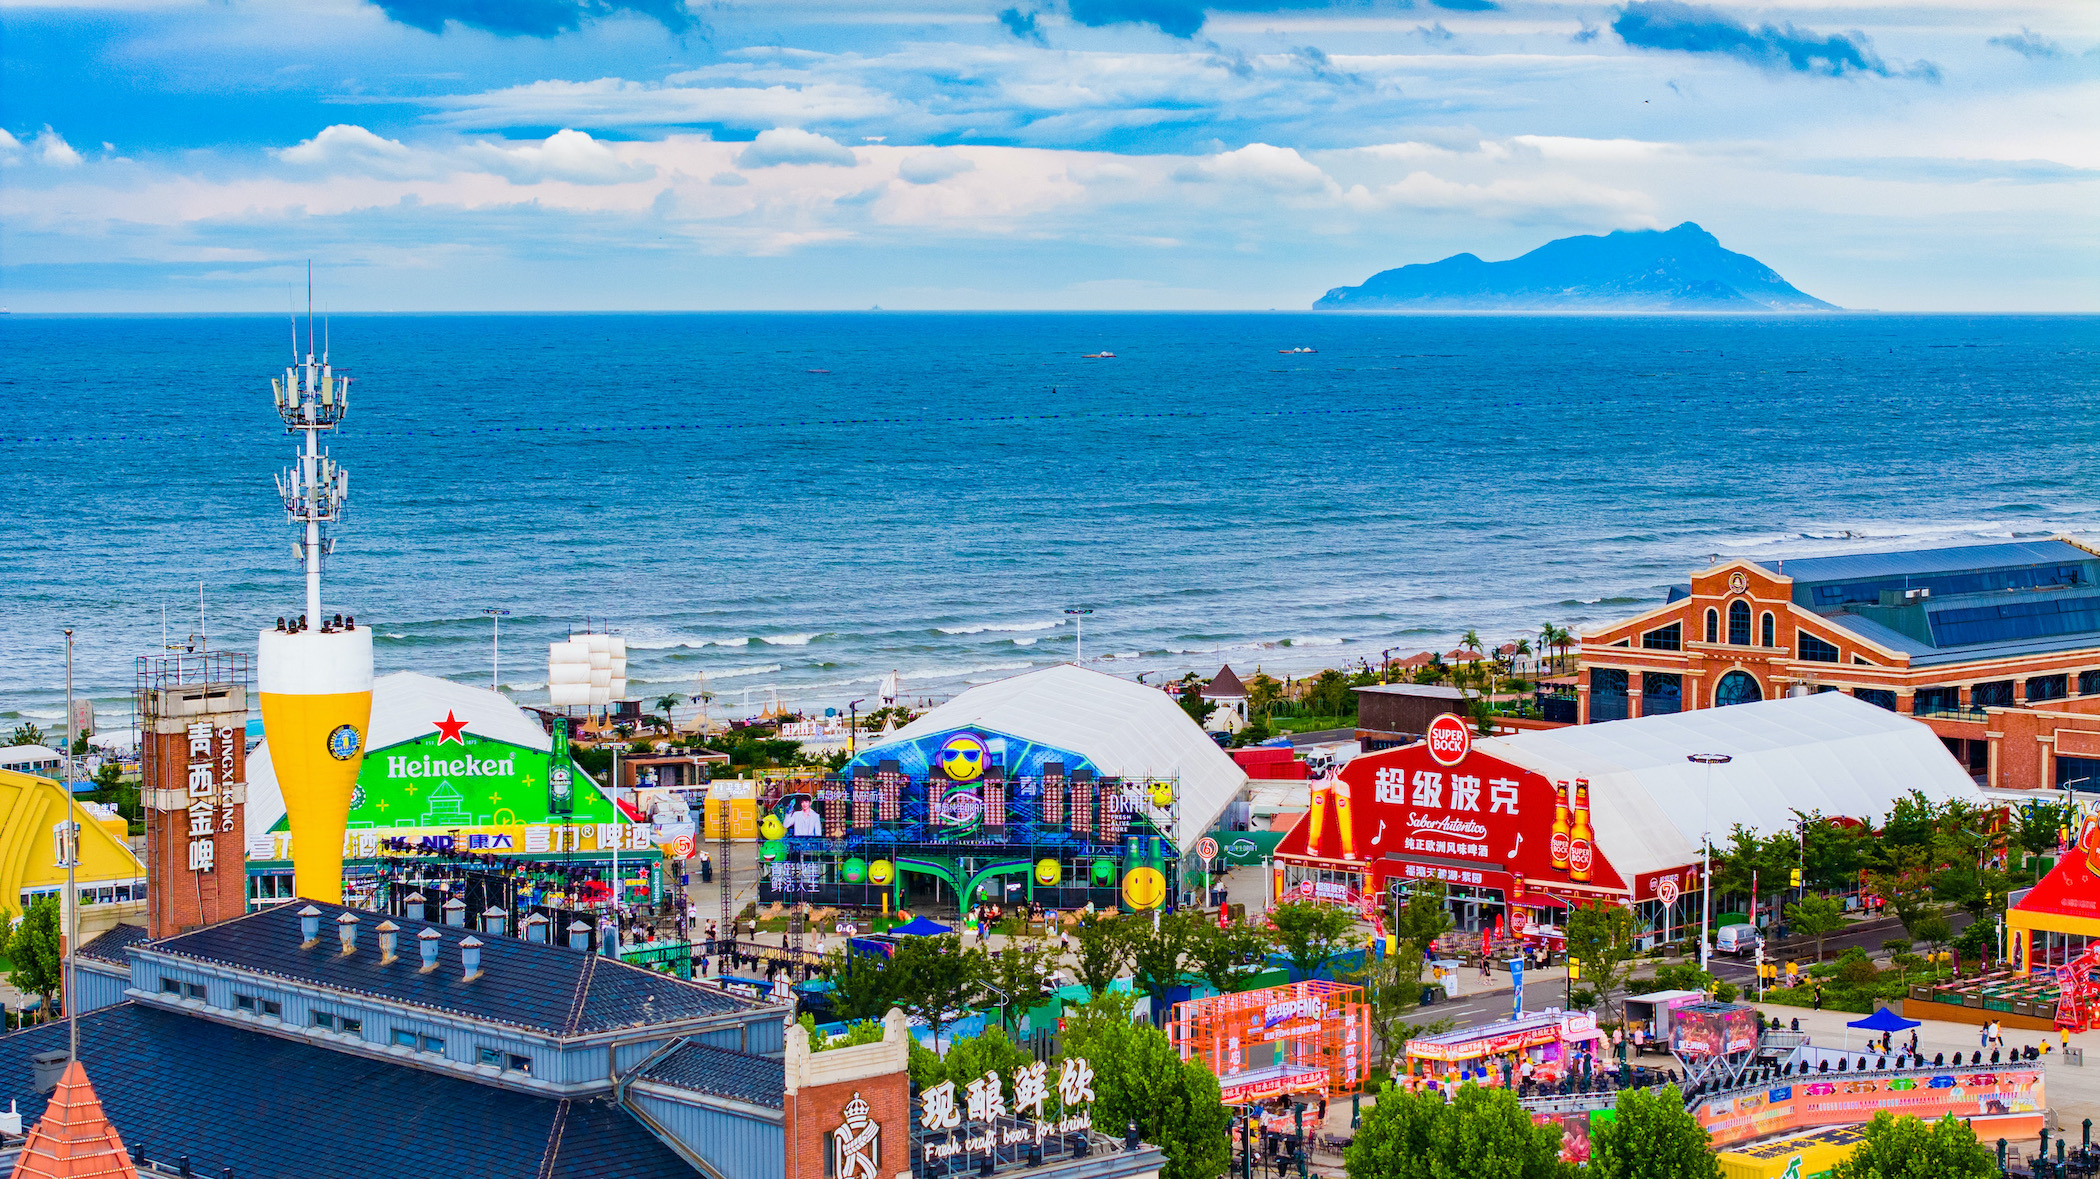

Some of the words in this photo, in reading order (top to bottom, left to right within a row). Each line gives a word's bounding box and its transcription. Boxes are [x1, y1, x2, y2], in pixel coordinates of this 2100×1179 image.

[1432, 728, 1463, 742] SUPER
[1433, 739, 1462, 752] BOCK
[219, 726, 234, 787] QINGXI
[387, 754, 516, 778] Heineken
[188, 722, 214, 873] 青西金啤
[1375, 767, 1520, 815] 超级波克
[222, 790, 235, 833] KING
[1406, 811, 1439, 829] Sabor
[469, 833, 513, 849] 康大
[678, 840, 690, 853] 5
[1203, 842, 1211, 854] 6
[1404, 837, 1489, 857] 纯正欧洲风味啤酒
[1571, 846, 1590, 856] SUPER
[1571, 853, 1589, 863] BOCK
[1662, 885, 1674, 900] 7
[920, 1057, 1096, 1131] 现酿鲜饮
[924, 1139, 962, 1162] Fresh
[965, 1129, 996, 1154] craft
[1003, 1126, 1030, 1145] beer
[1035, 1119, 1055, 1145] for
[1059, 1110, 1092, 1133] drink
